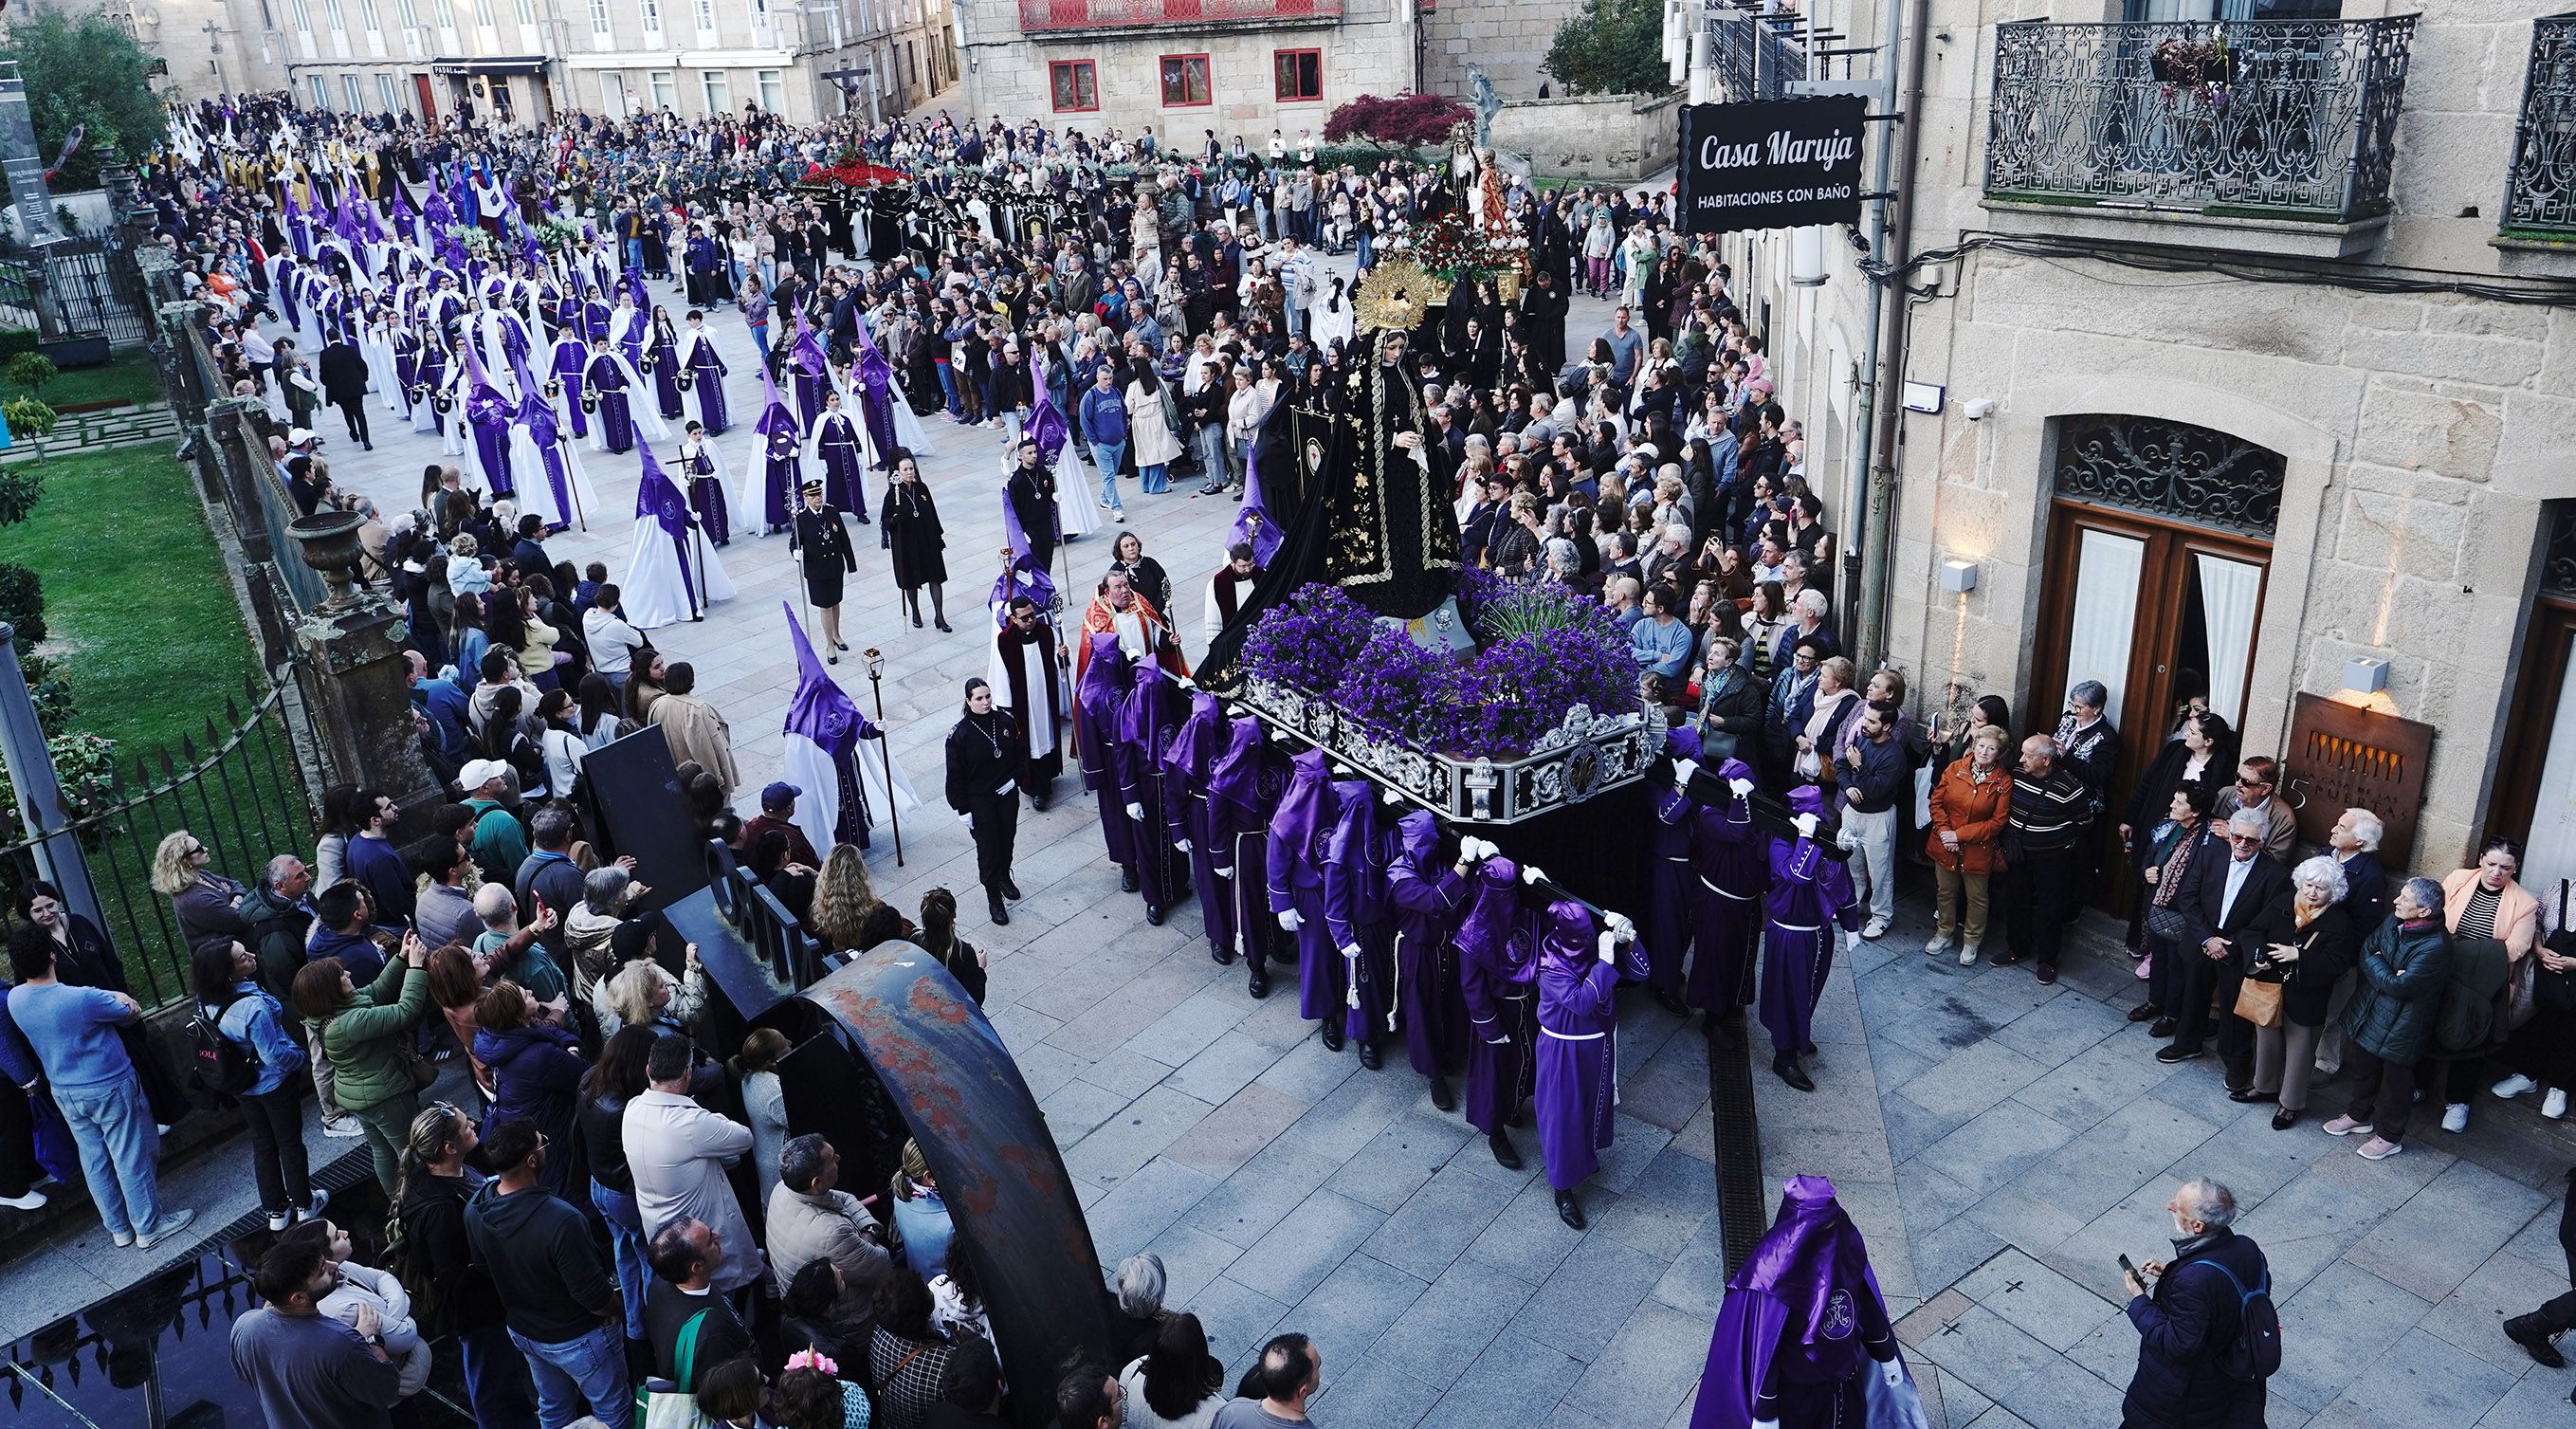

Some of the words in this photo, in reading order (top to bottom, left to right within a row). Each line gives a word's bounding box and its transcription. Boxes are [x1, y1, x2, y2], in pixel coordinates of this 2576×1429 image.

[1700, 135, 1762, 171] Casa
[1766, 128, 1855, 173] Maruja
[1698, 190, 1783, 210] HABITACIONES
[1786, 188, 1814, 203] CON
[1817, 183, 1851, 200] BAÑO
[2291, 779, 2310, 810] 5
[2314, 785, 2408, 822] PUERTAS
[2321, 777, 2350, 790] CASA
[2378, 793, 2398, 803] LAS
